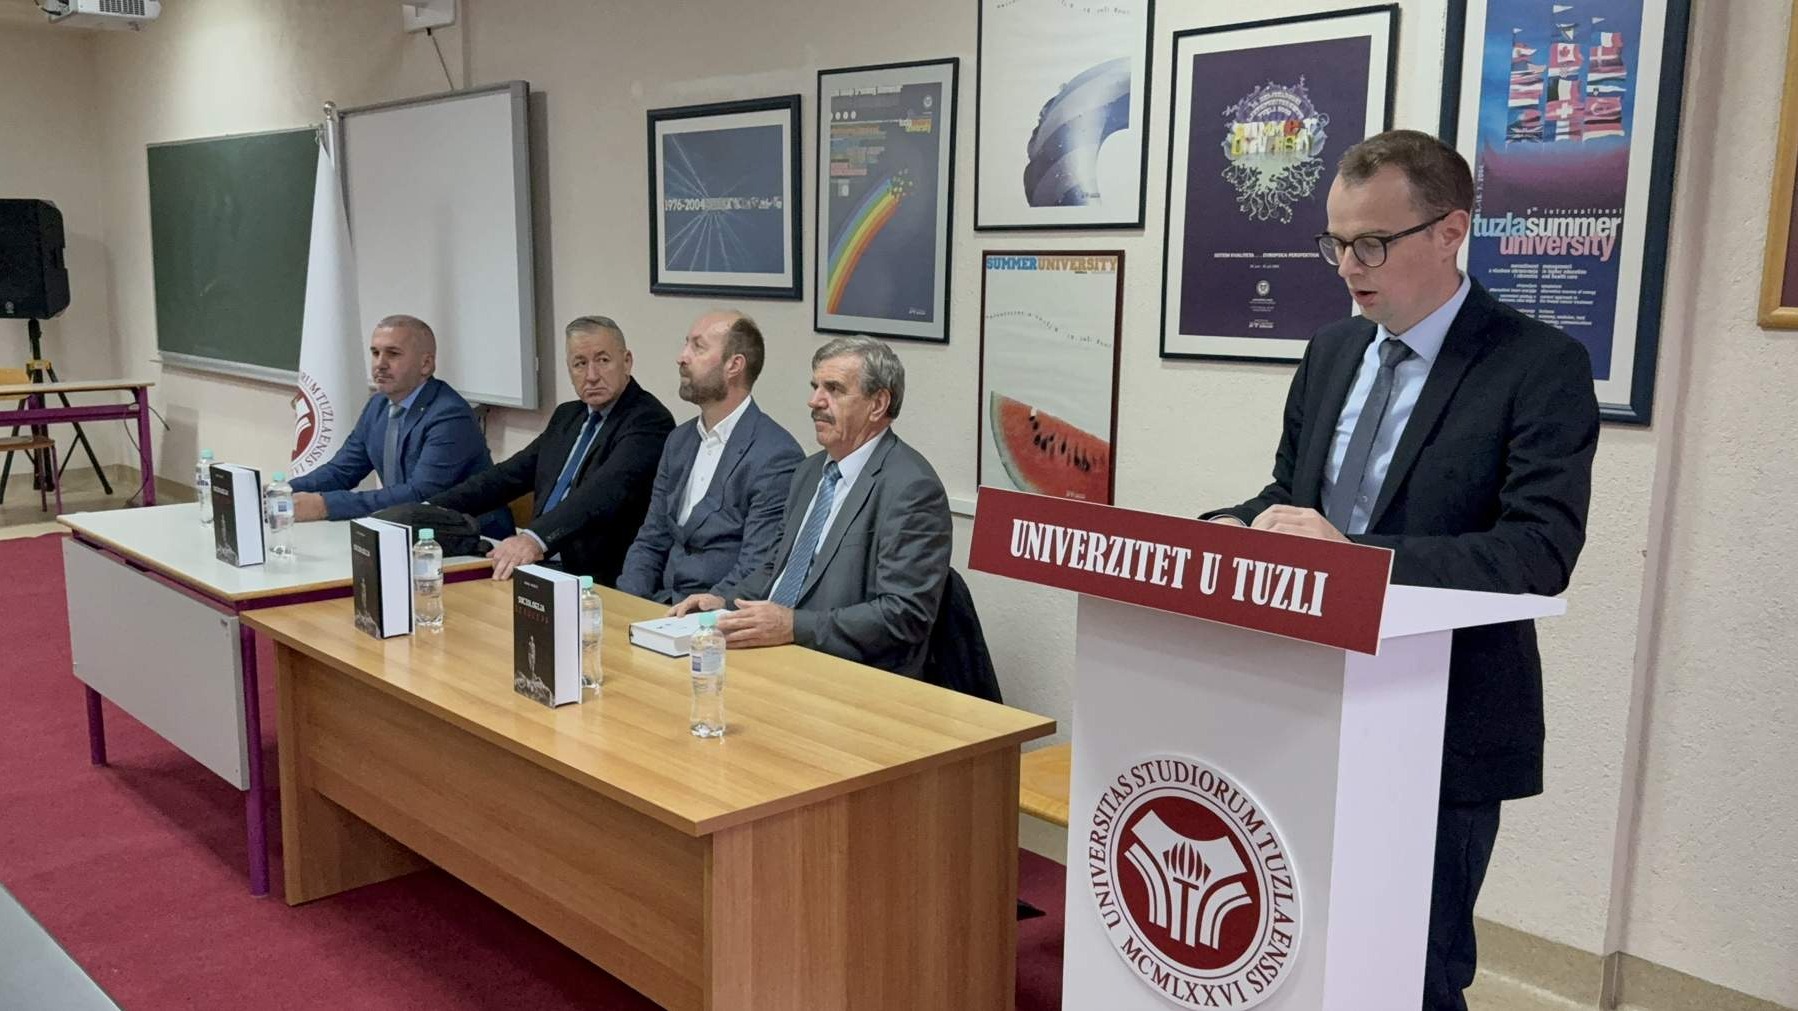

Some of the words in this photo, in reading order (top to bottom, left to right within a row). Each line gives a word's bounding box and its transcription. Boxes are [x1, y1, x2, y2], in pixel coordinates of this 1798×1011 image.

[664, 198, 705, 212] 1976-2004
[1500, 235, 1616, 262] university
[1010, 518, 1191, 590] UNIVERZITET
[1199, 551, 1223, 596] U
[1231, 557, 1329, 617] TUZLI
[1089, 774, 1134, 931] UNIVERSITAS
[1130, 760, 1265, 837] STUDIORUM
[1246, 831, 1296, 994] TUZLAENSIS
[1120, 934, 1249, 1008] MCMLXXVI
